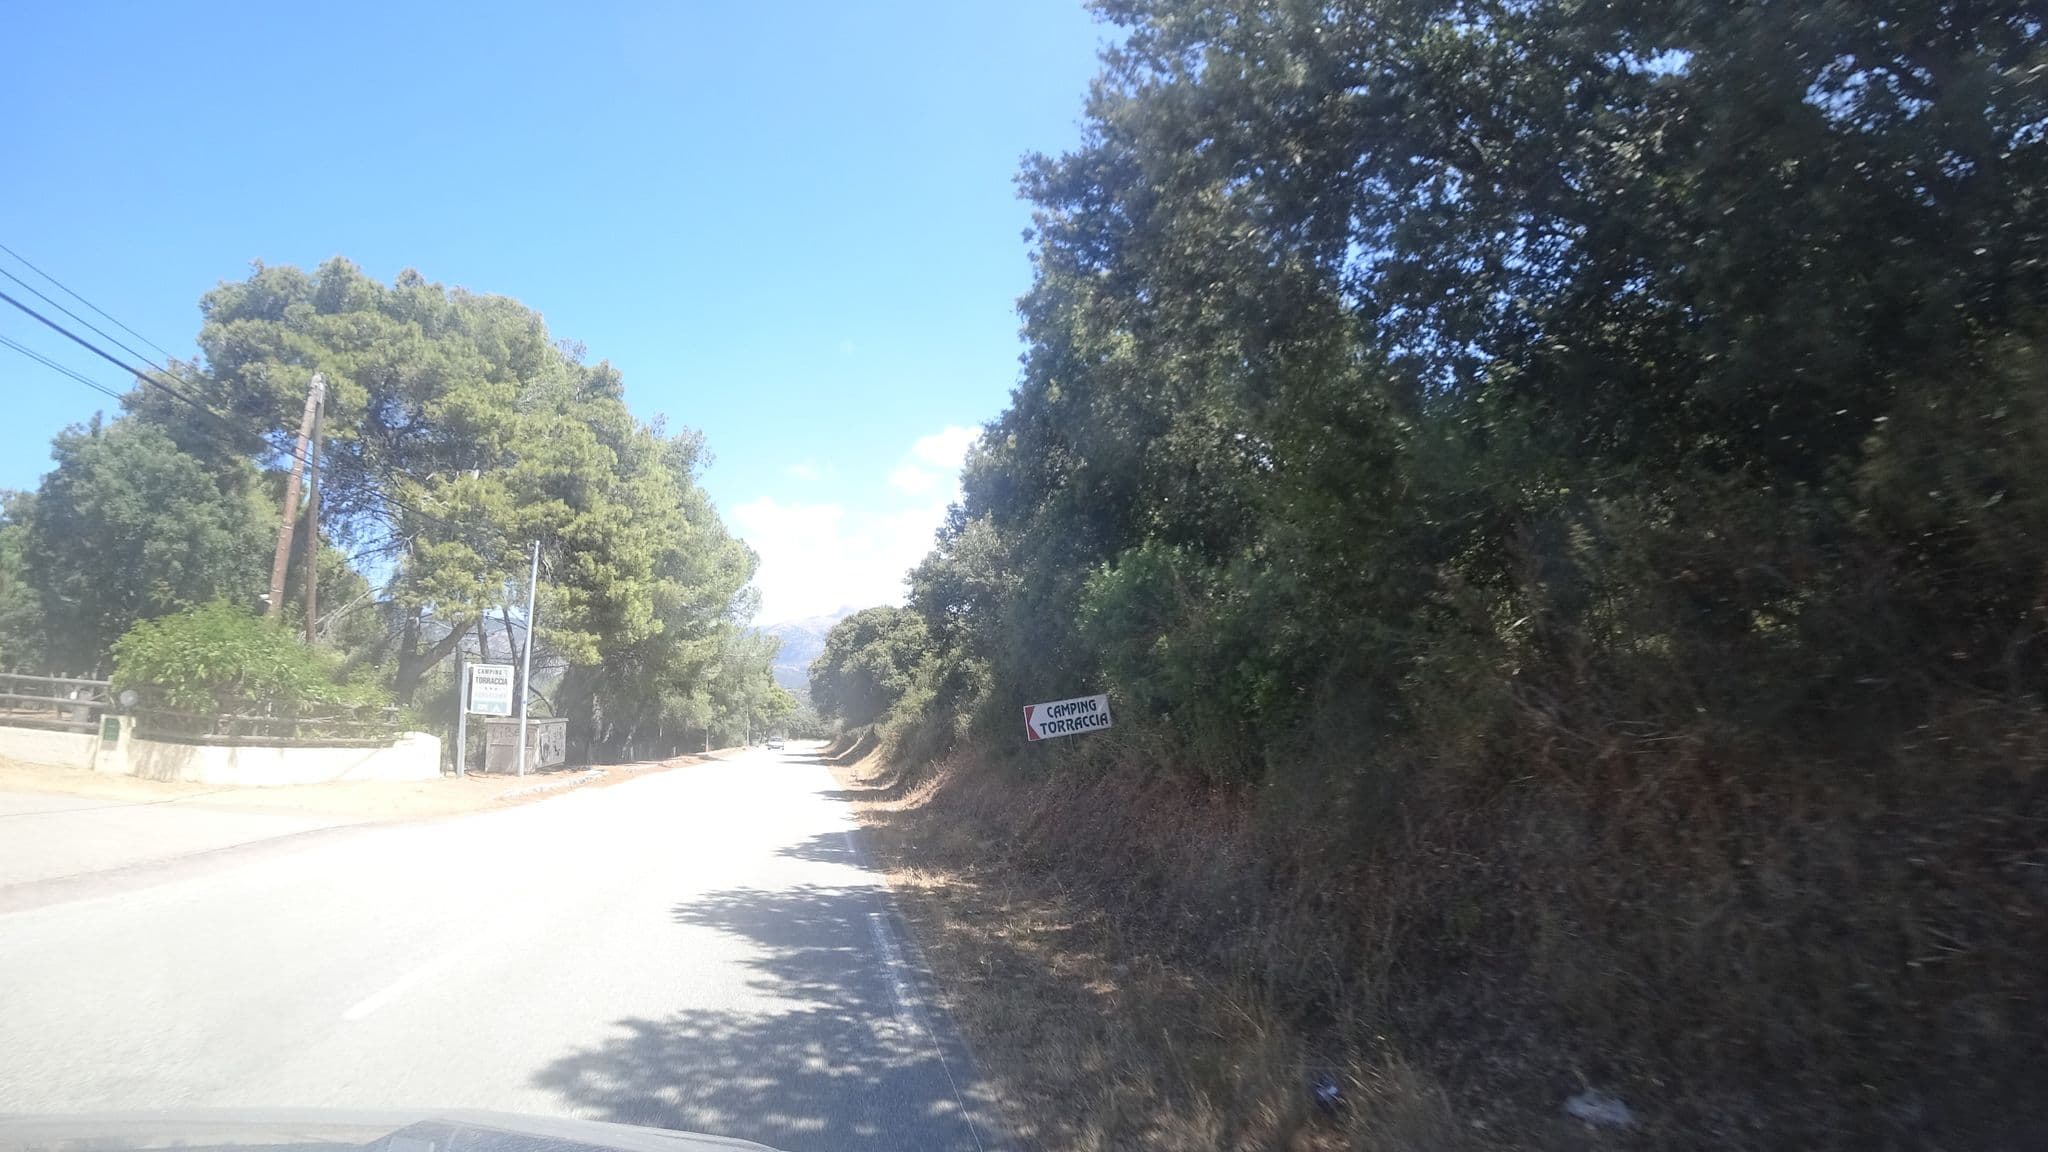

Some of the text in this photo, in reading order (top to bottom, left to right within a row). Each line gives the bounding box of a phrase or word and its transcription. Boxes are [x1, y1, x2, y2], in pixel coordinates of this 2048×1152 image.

[475, 676, 508, 685] TORRACCIA
[1047, 699, 1097, 719] CAMPING
[1040, 713, 1109, 735] TORRACCIA
